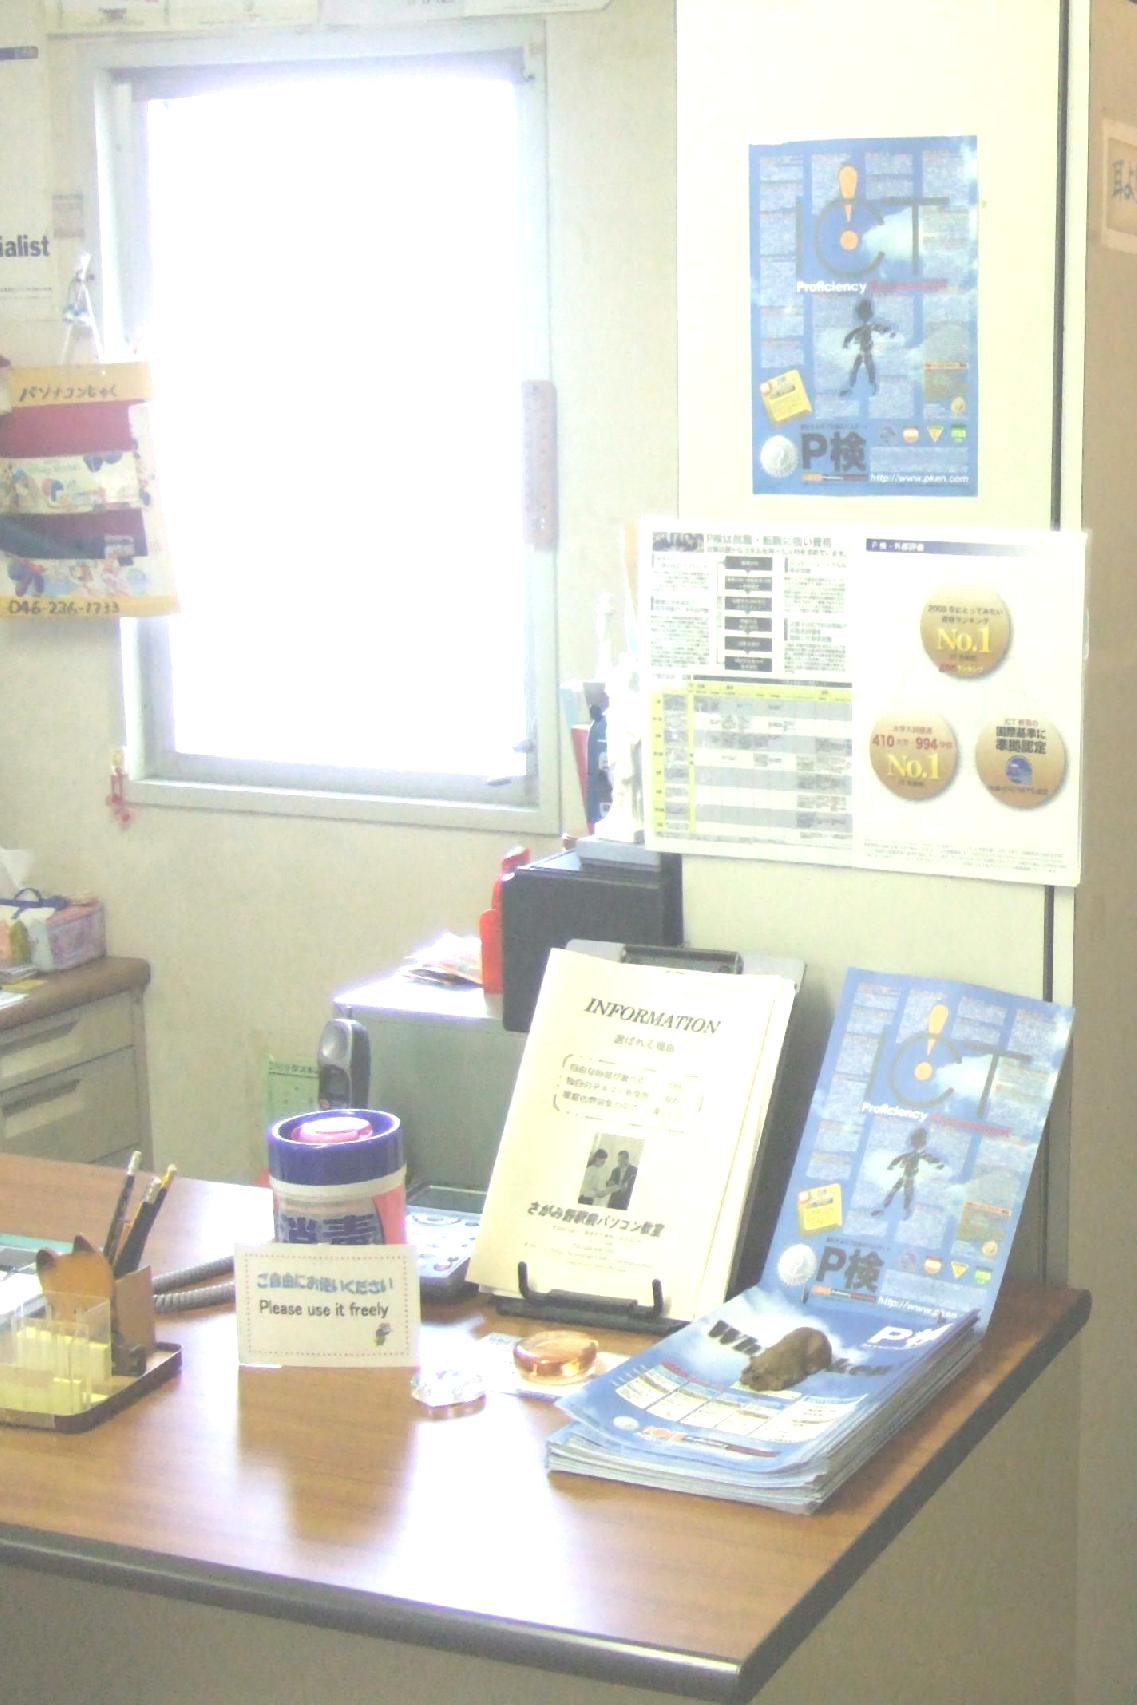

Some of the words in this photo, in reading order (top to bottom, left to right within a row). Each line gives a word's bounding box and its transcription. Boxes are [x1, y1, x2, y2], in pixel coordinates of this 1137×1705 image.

[796, 280, 867, 295] Proficiency
[801, 431, 867, 472] P検
[936, 626, 992, 653] No.1
[887, 752, 940, 780] No.1
[584, 997, 722, 1034] INFORMATION
[862, 1102, 928, 1123] Proficiency
[816, 1245, 885, 1293] P検
[258, 1299, 303, 1315] Please
[308, 1304, 331, 1317] use
[335, 1301, 345, 1317] it
[349, 1301, 389, 1319] freely
